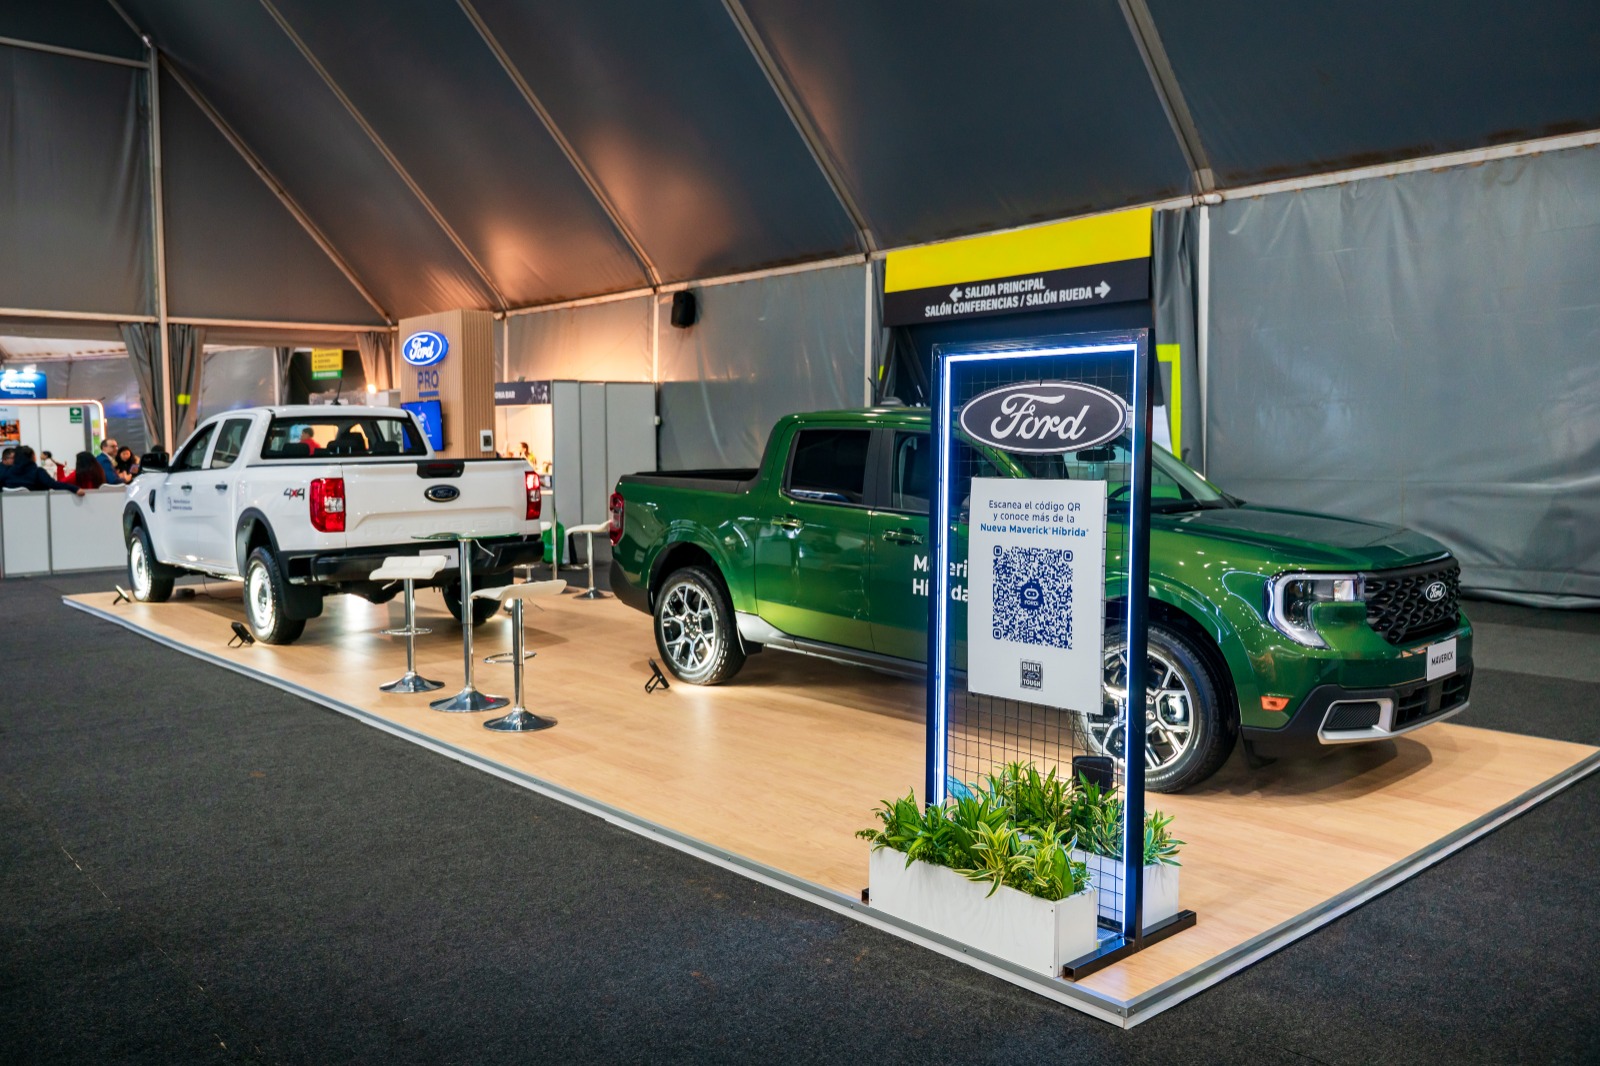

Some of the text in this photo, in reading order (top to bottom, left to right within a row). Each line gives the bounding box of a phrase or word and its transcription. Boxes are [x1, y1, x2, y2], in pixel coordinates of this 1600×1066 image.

[965, 279, 1045, 299] SALIDA PRINCIPAL
[925, 300, 952, 317] SALÓN
[952, 295, 1019, 314] CONFERENCIAS
[1026, 289, 1057, 306] SALÓN
[1059, 286, 1093, 303] RUEDA
[408, 336, 435, 361] Ford
[417, 370, 439, 389] PRO
[990, 393, 1090, 440] Ford
[988, 499, 1081, 512] Escanea el código QR
[993, 512, 1075, 523] y conoce más de la
[980, 523, 1007, 533] Nueva
[1430, 584, 1443, 599] Ford
[1431, 651, 1454, 666] MAVERICK
[1022, 662, 1041, 673] BUILT
[1022, 679, 1041, 688] TOUGH
